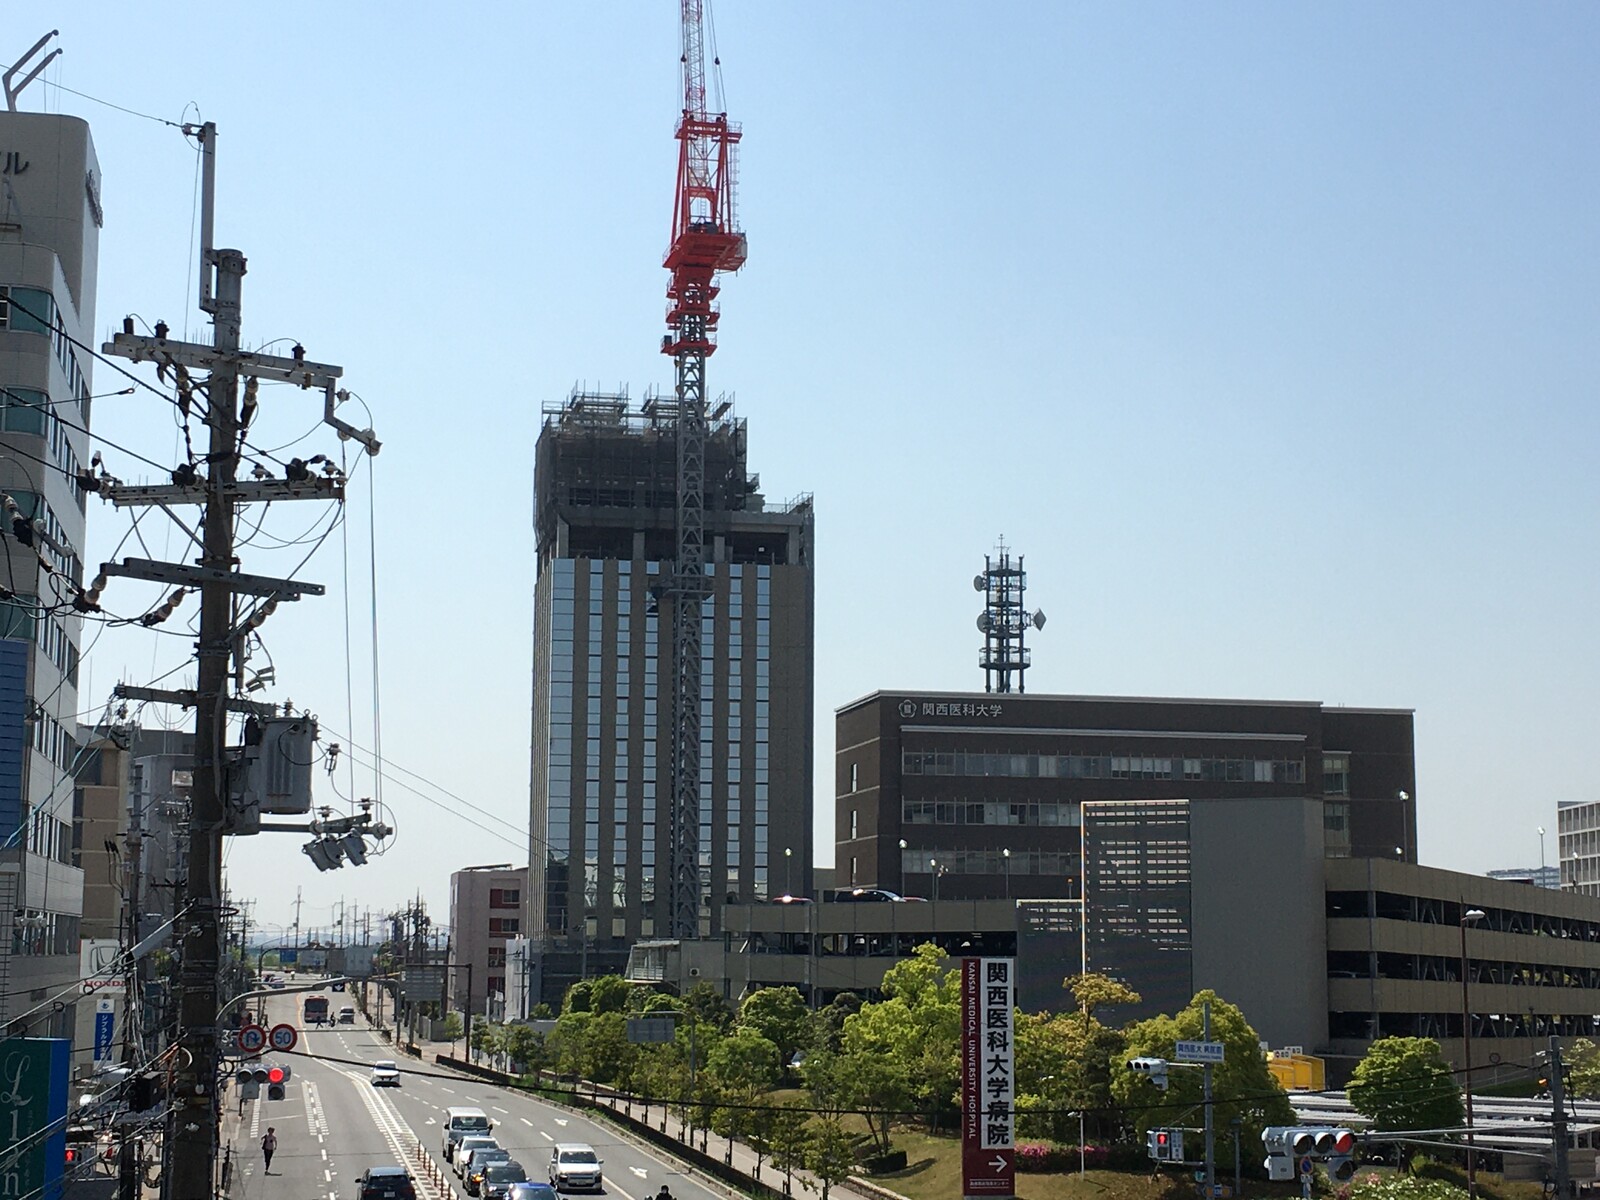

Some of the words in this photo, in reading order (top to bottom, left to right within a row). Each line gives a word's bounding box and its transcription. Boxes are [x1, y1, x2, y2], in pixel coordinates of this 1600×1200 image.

[0, 151, 30, 175] ル
[922, 702, 1003, 718] 関西医科大学
[968, 961, 976, 994] KANSAI
[968, 996, 976, 1037] MEDICAL
[275, 1031, 292, 1045] 50
[986, 962, 1010, 1146] 関西医科大学病院
[968, 1040, 976, 1092] UNIVERSITY
[968, 1095, 976, 1139] HOSPITAL
